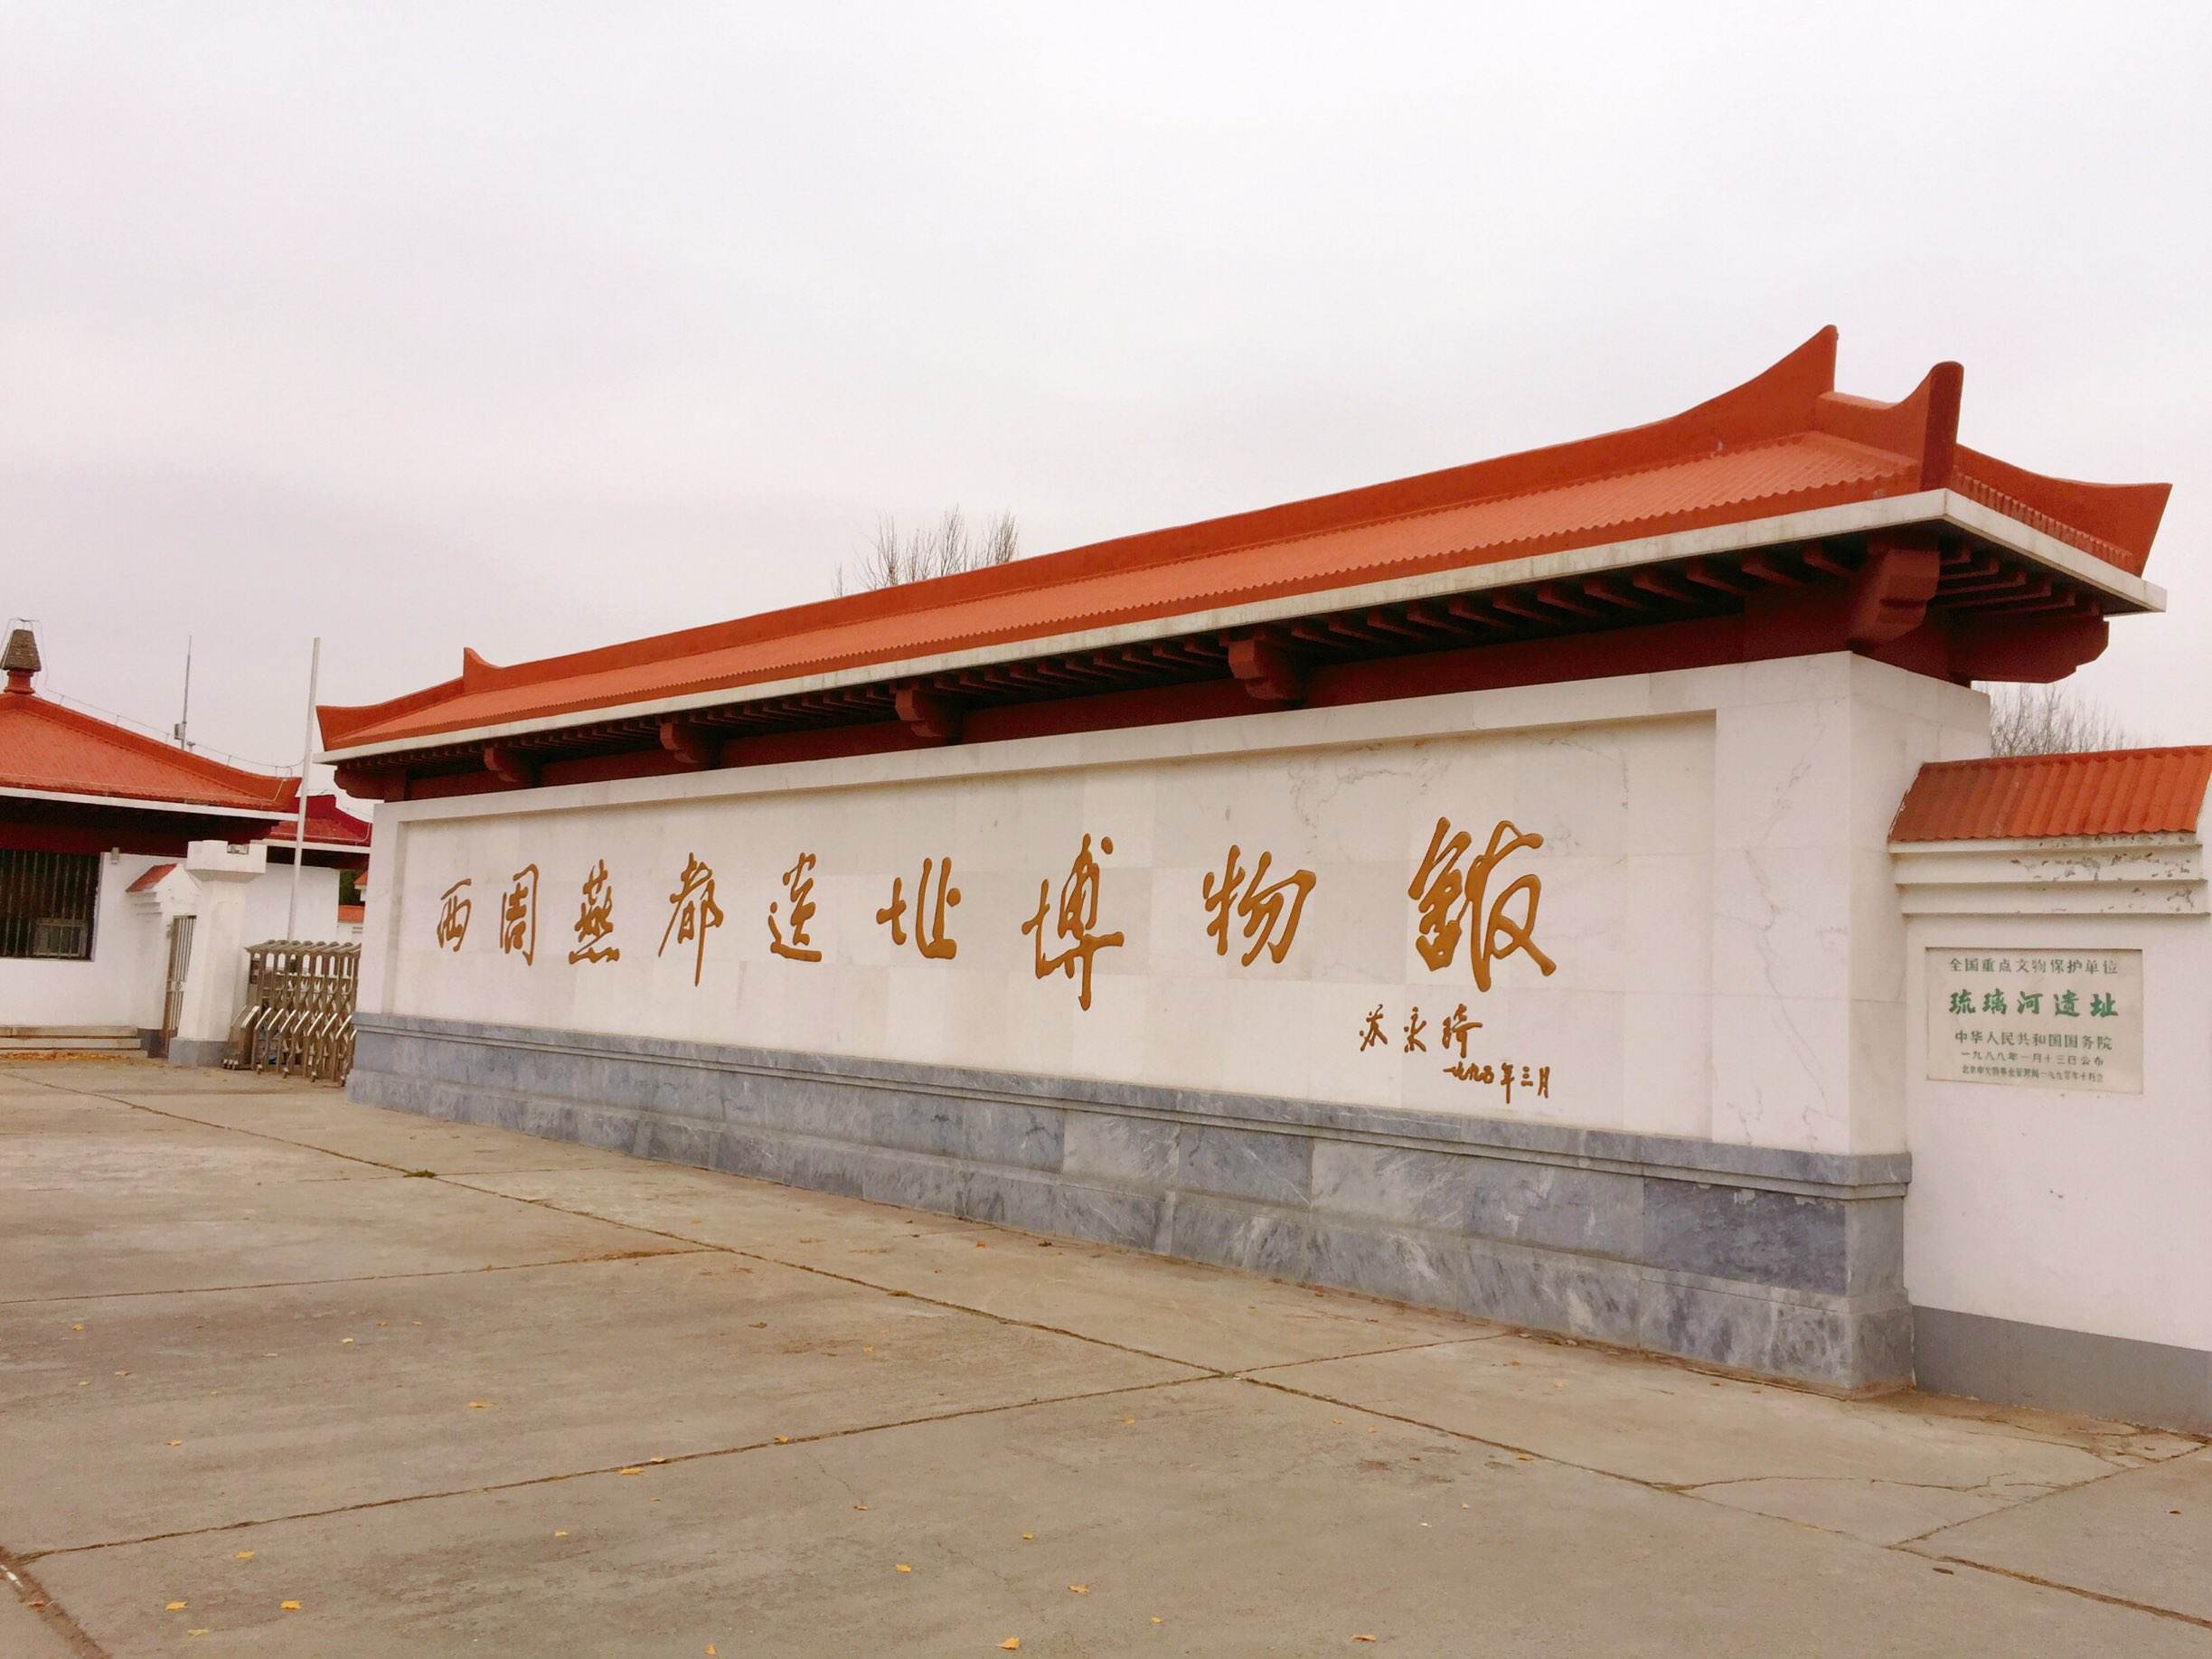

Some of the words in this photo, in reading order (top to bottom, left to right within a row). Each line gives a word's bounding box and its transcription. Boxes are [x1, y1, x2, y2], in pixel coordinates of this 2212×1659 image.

[1949, 957, 2119, 975] 全国重点文物保护单位
[1948, 988, 2119, 1017] 琉璃河遗址
[1954, 1031, 2113, 1051] 中华人民共和国国务院
[1961, 1051, 2104, 1067] 一九八八年一月十三日公布
